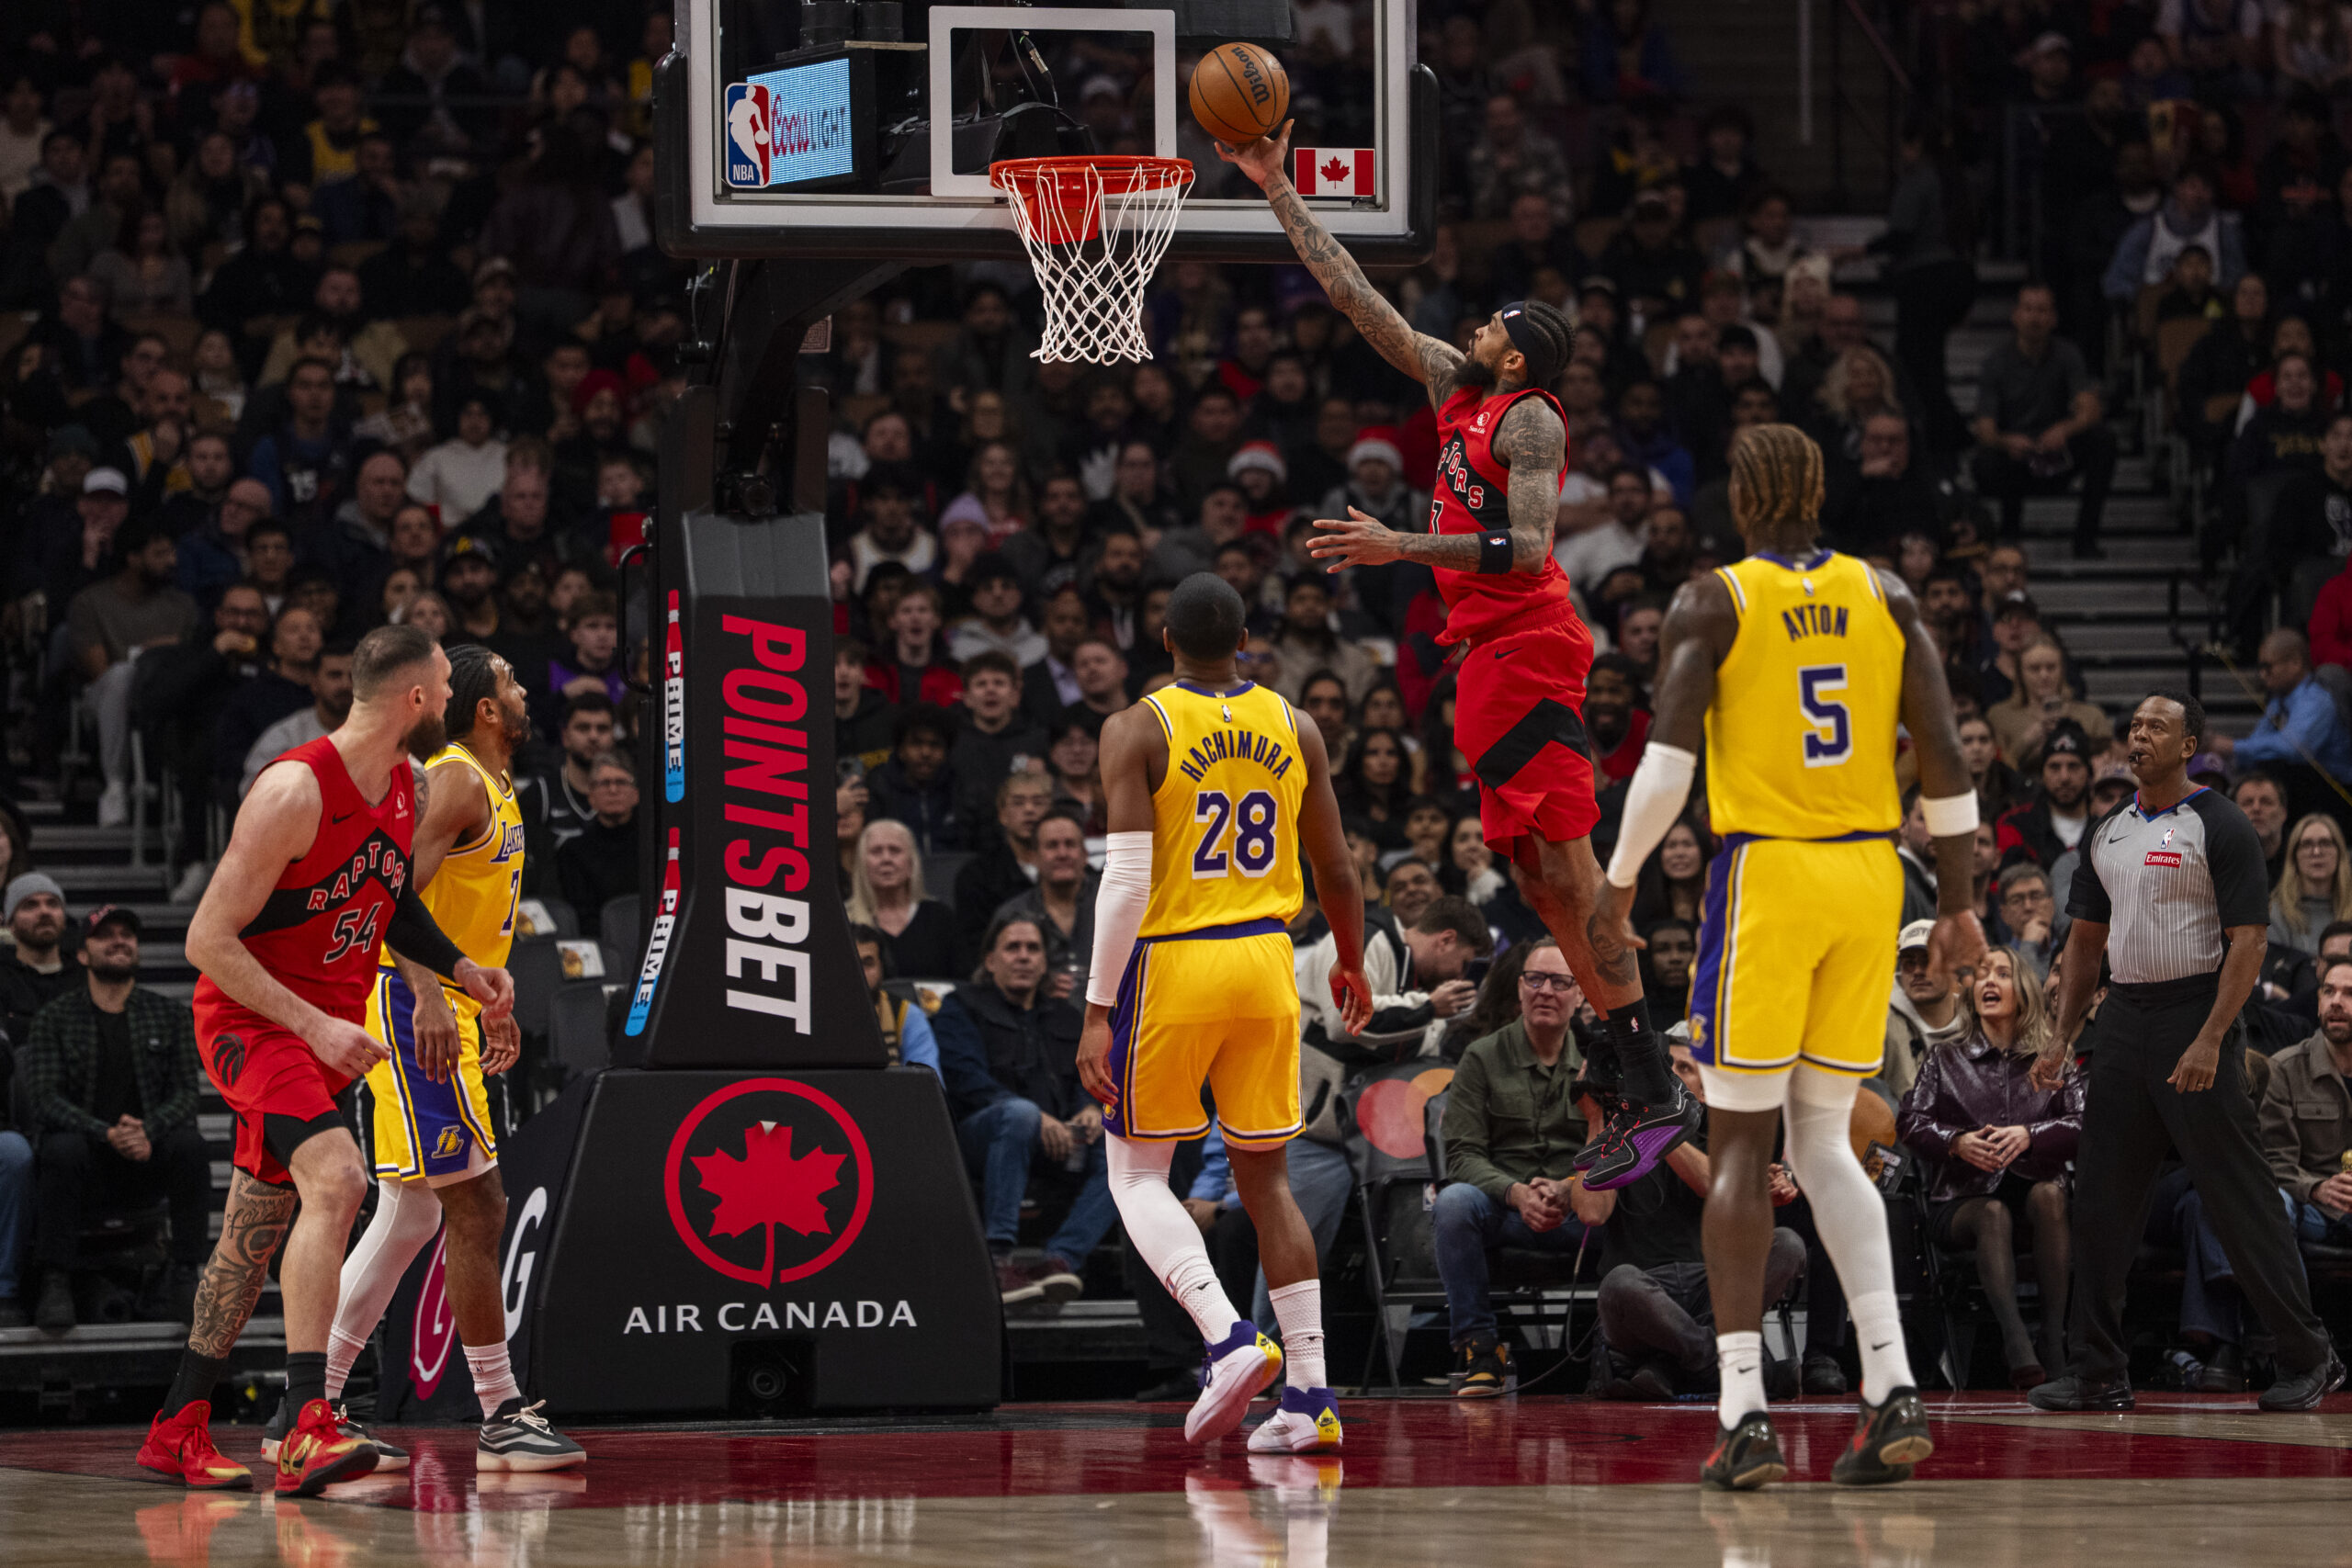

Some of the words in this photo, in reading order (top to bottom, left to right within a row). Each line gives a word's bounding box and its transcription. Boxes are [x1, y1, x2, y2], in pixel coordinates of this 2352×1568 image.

[1231, 47, 1270, 106] Wilson
[772, 94, 809, 157] Coors
[810, 107, 845, 151] LIGHT
[732, 164, 755, 181] NBA
[1781, 603, 1849, 642] AYTON
[667, 650, 683, 773] PRIME
[1797, 662, 1854, 769] 5
[1180, 729, 1294, 783] HACHIMURA
[721, 614, 812, 1036] POINTSBET
[1192, 789, 1279, 879] 28
[307, 841, 406, 910] RAPTOR
[2145, 853, 2180, 865] Emirates
[322, 901, 384, 964] 54
[499, 868, 521, 936] 7
[633, 889, 678, 1009] PRIME
[624, 1304, 704, 1334] AIR
[717, 1300, 919, 1331] CANADA
